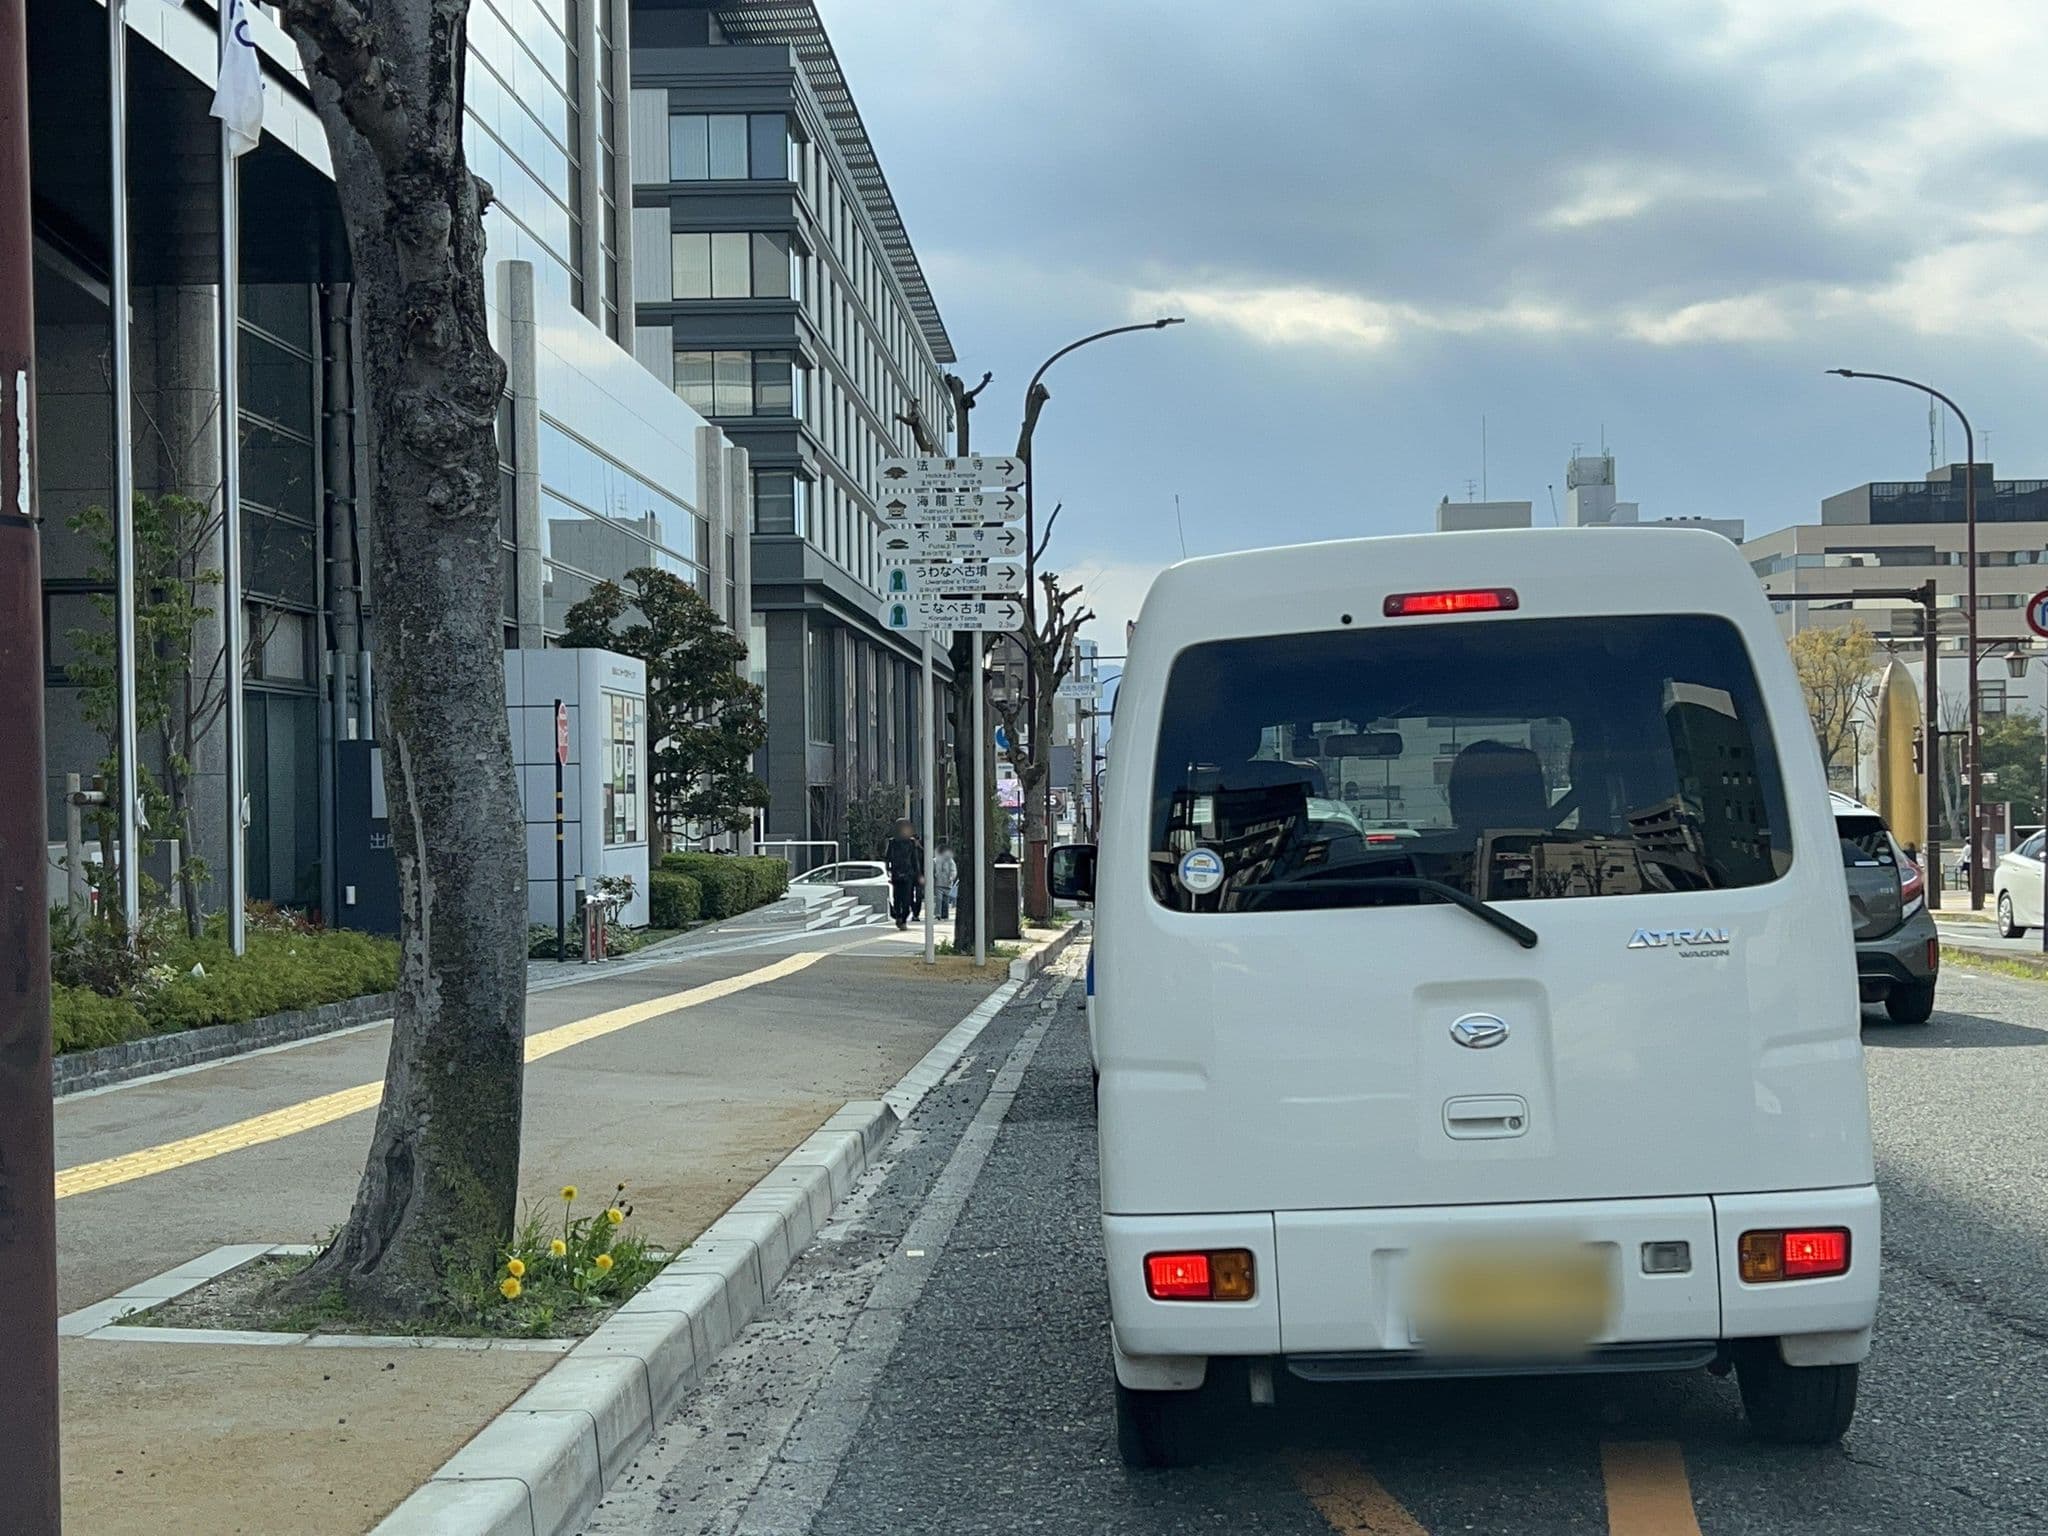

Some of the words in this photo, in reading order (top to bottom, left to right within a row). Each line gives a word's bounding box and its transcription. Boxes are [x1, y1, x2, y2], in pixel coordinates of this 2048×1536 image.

[917, 459, 984, 472] 法華寺
[917, 495, 984, 507] 海龍王寺
[917, 529, 985, 542] 不退寺
[916, 565, 988, 577] うわなべ古墳
[919, 602, 986, 615] こなべ古墳
[1627, 927, 1729, 949] ATRAI
[1679, 949, 1729, 959] WAGON
